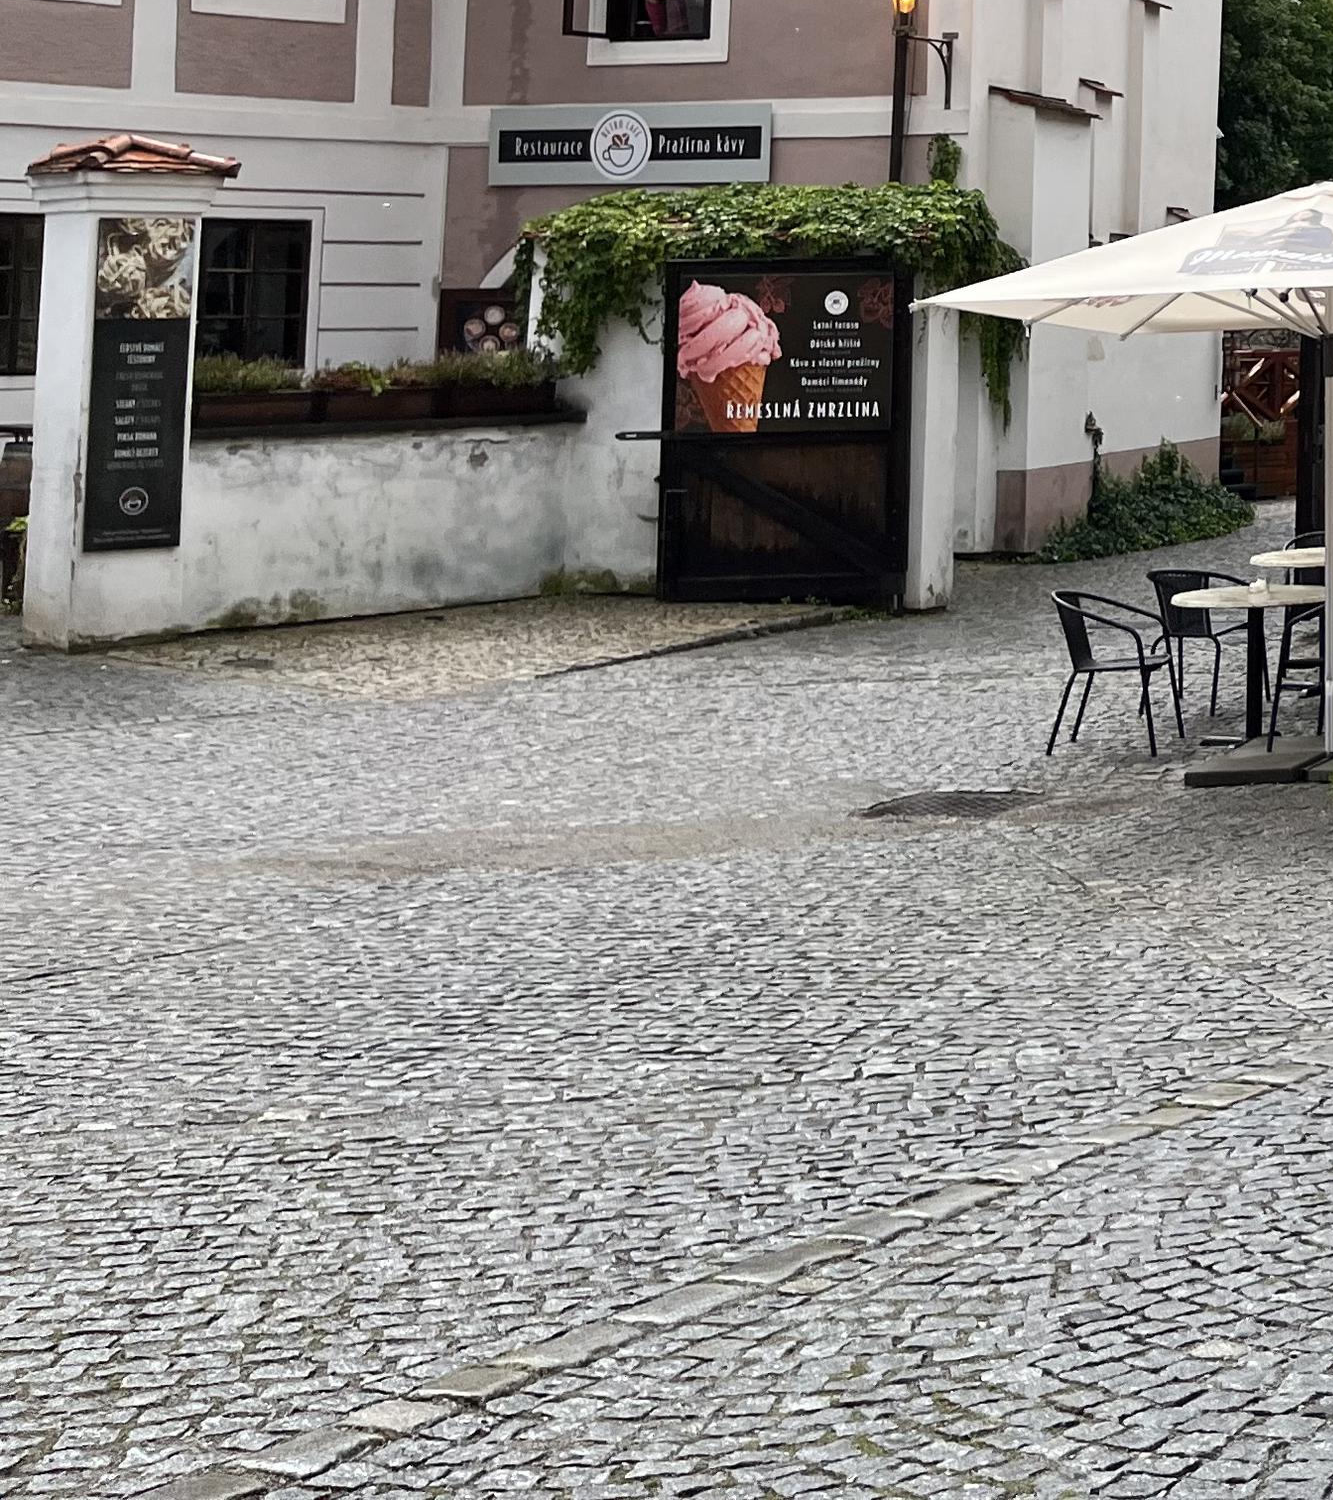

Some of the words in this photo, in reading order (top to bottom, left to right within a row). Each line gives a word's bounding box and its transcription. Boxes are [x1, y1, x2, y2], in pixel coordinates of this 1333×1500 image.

[514, 136, 583, 157] Restaurace
[658, 134, 711, 154] Pražírna
[716, 132, 746, 156] kávy
[726, 399, 801, 420] ŘEMESLNÁ
[807, 401, 880, 419] ZMRZLINA
